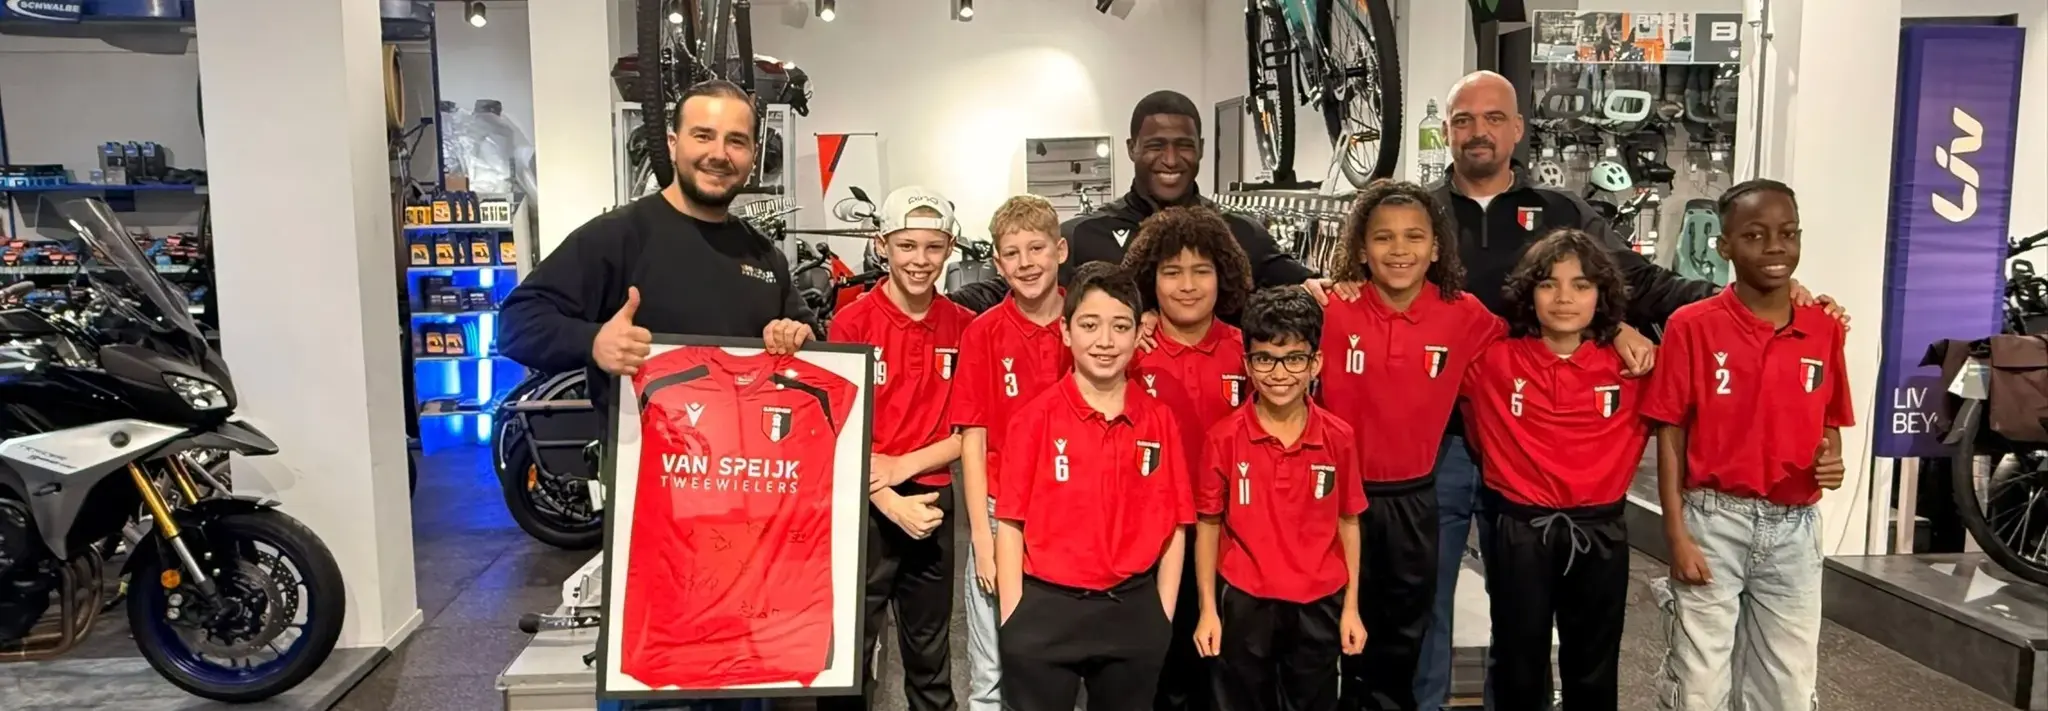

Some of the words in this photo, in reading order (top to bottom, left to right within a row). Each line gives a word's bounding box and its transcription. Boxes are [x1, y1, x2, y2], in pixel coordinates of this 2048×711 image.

[20, 1, 81, 13] SCHWALBE
[1931, 107, 1983, 222] Liv
[1346, 348, 1365, 375] 10
[1004, 372, 1019, 397] 3
[1715, 368, 1731, 395] 2
[1511, 392, 1524, 417] 5
[1894, 387, 1928, 409] LIV
[1892, 412, 1938, 434] BEY
[661, 453, 708, 475] VAN
[718, 457, 800, 479] SPEIJK
[1054, 455, 1070, 482] 6
[660, 475, 798, 494] TWEEWIELERS
[1239, 478, 1250, 505] 11
